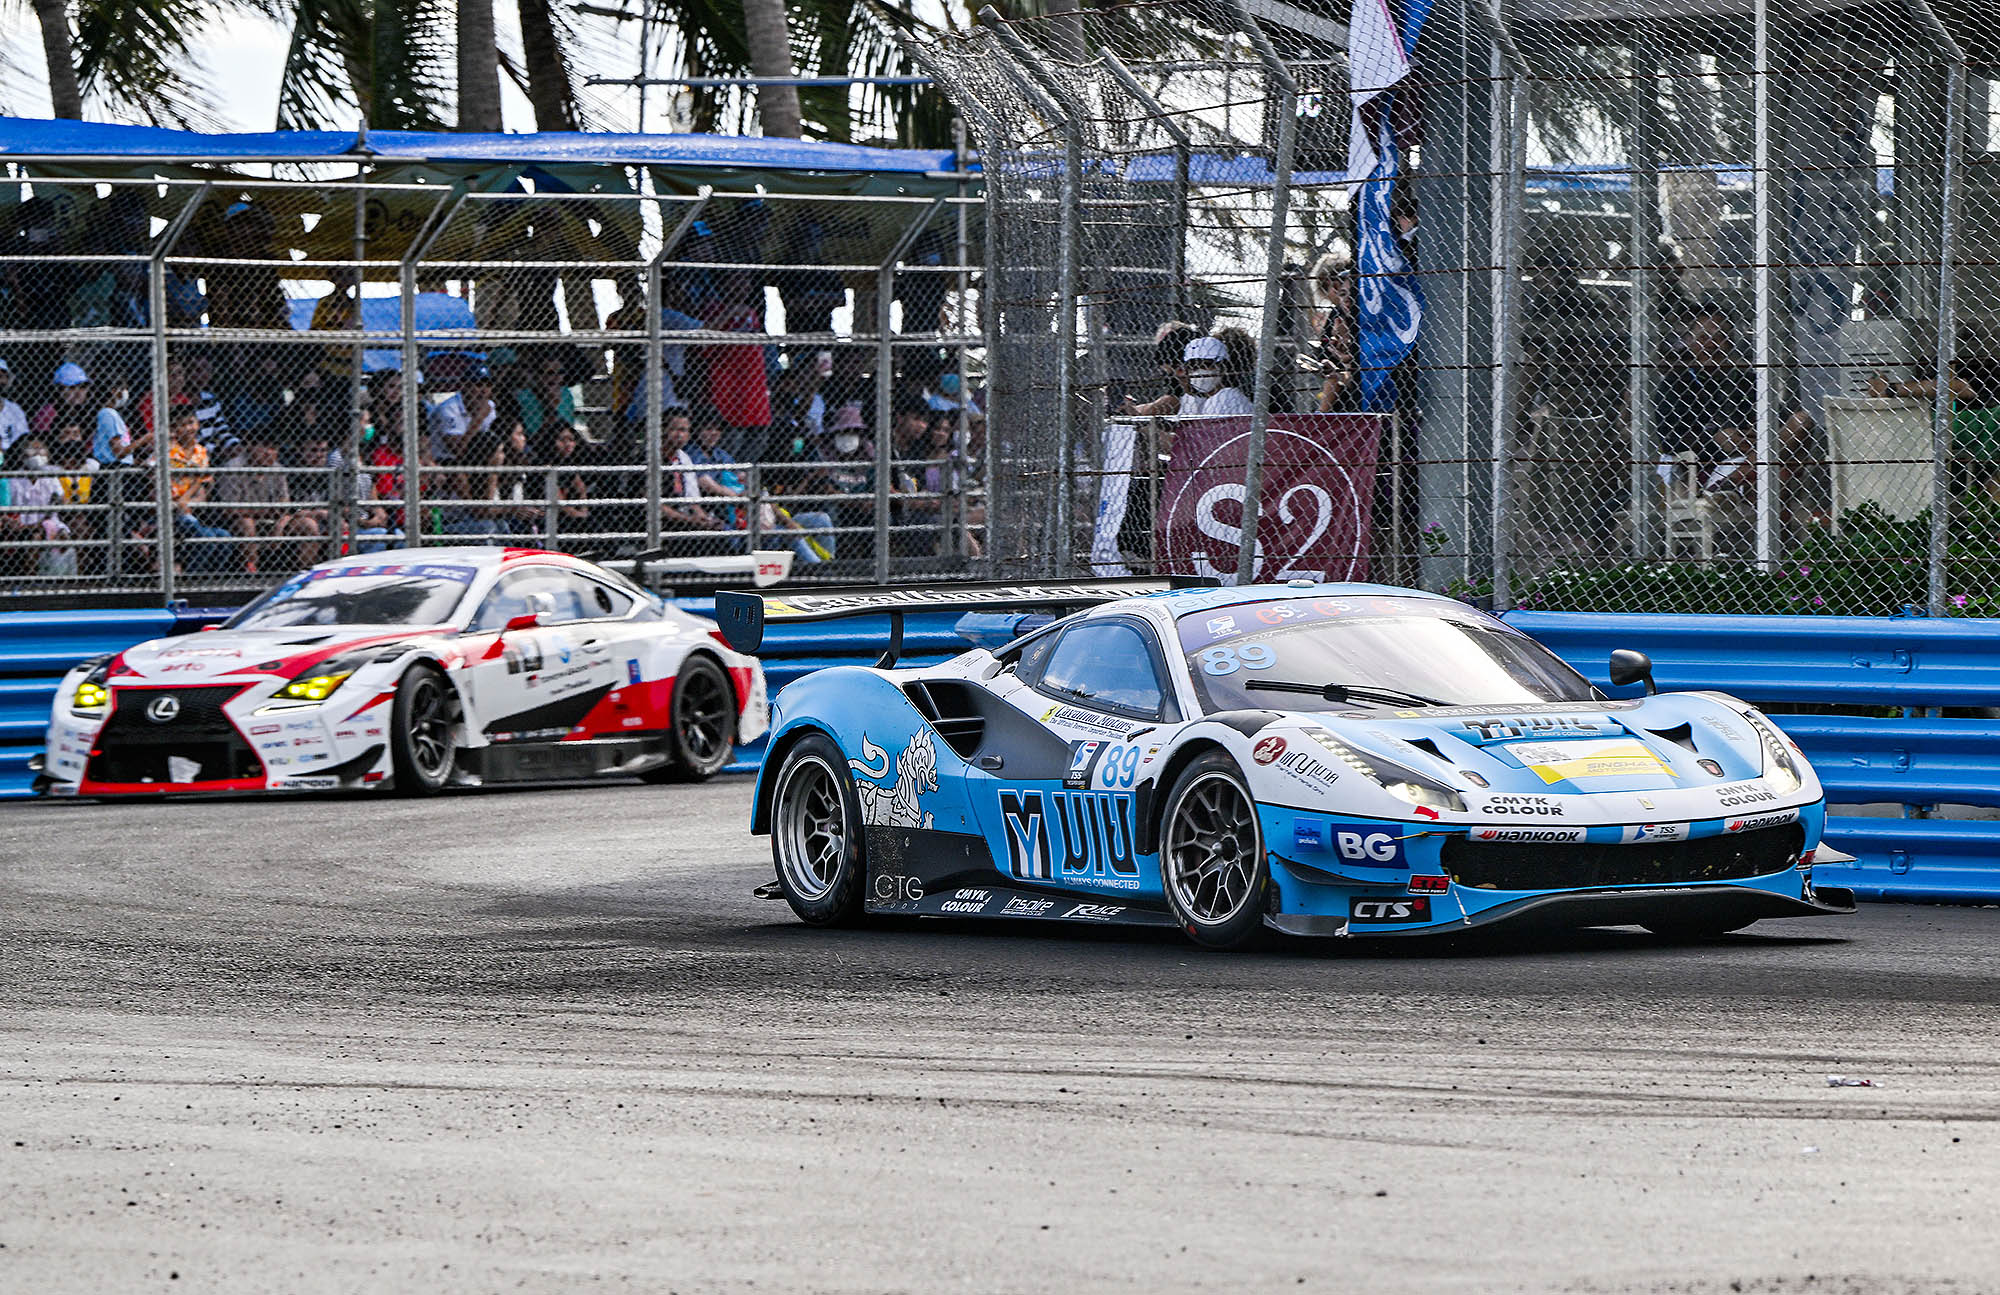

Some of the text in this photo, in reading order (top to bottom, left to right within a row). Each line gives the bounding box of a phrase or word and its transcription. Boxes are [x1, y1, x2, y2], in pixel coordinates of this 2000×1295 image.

[1190, 483, 1332, 586] S2
[1202, 643, 1277, 676] 89
[1101, 745, 1141, 788] 89
[1715, 783, 1757, 796] CMYK
[1490, 796, 1549, 806] CMYK
[1719, 791, 1777, 807] COLOUR
[1481, 805, 1565, 817] COLOUR
[1337, 832, 1397, 862] BG
[874, 874, 924, 901] CTG
[1063, 876, 1140, 890] ALWAYS CONNECTED
[1411, 876, 1449, 889] ETS
[954, 888, 989, 901] CMYK
[940, 900, 985, 913] COLOUR
[1353, 901, 1413, 918] CTS
